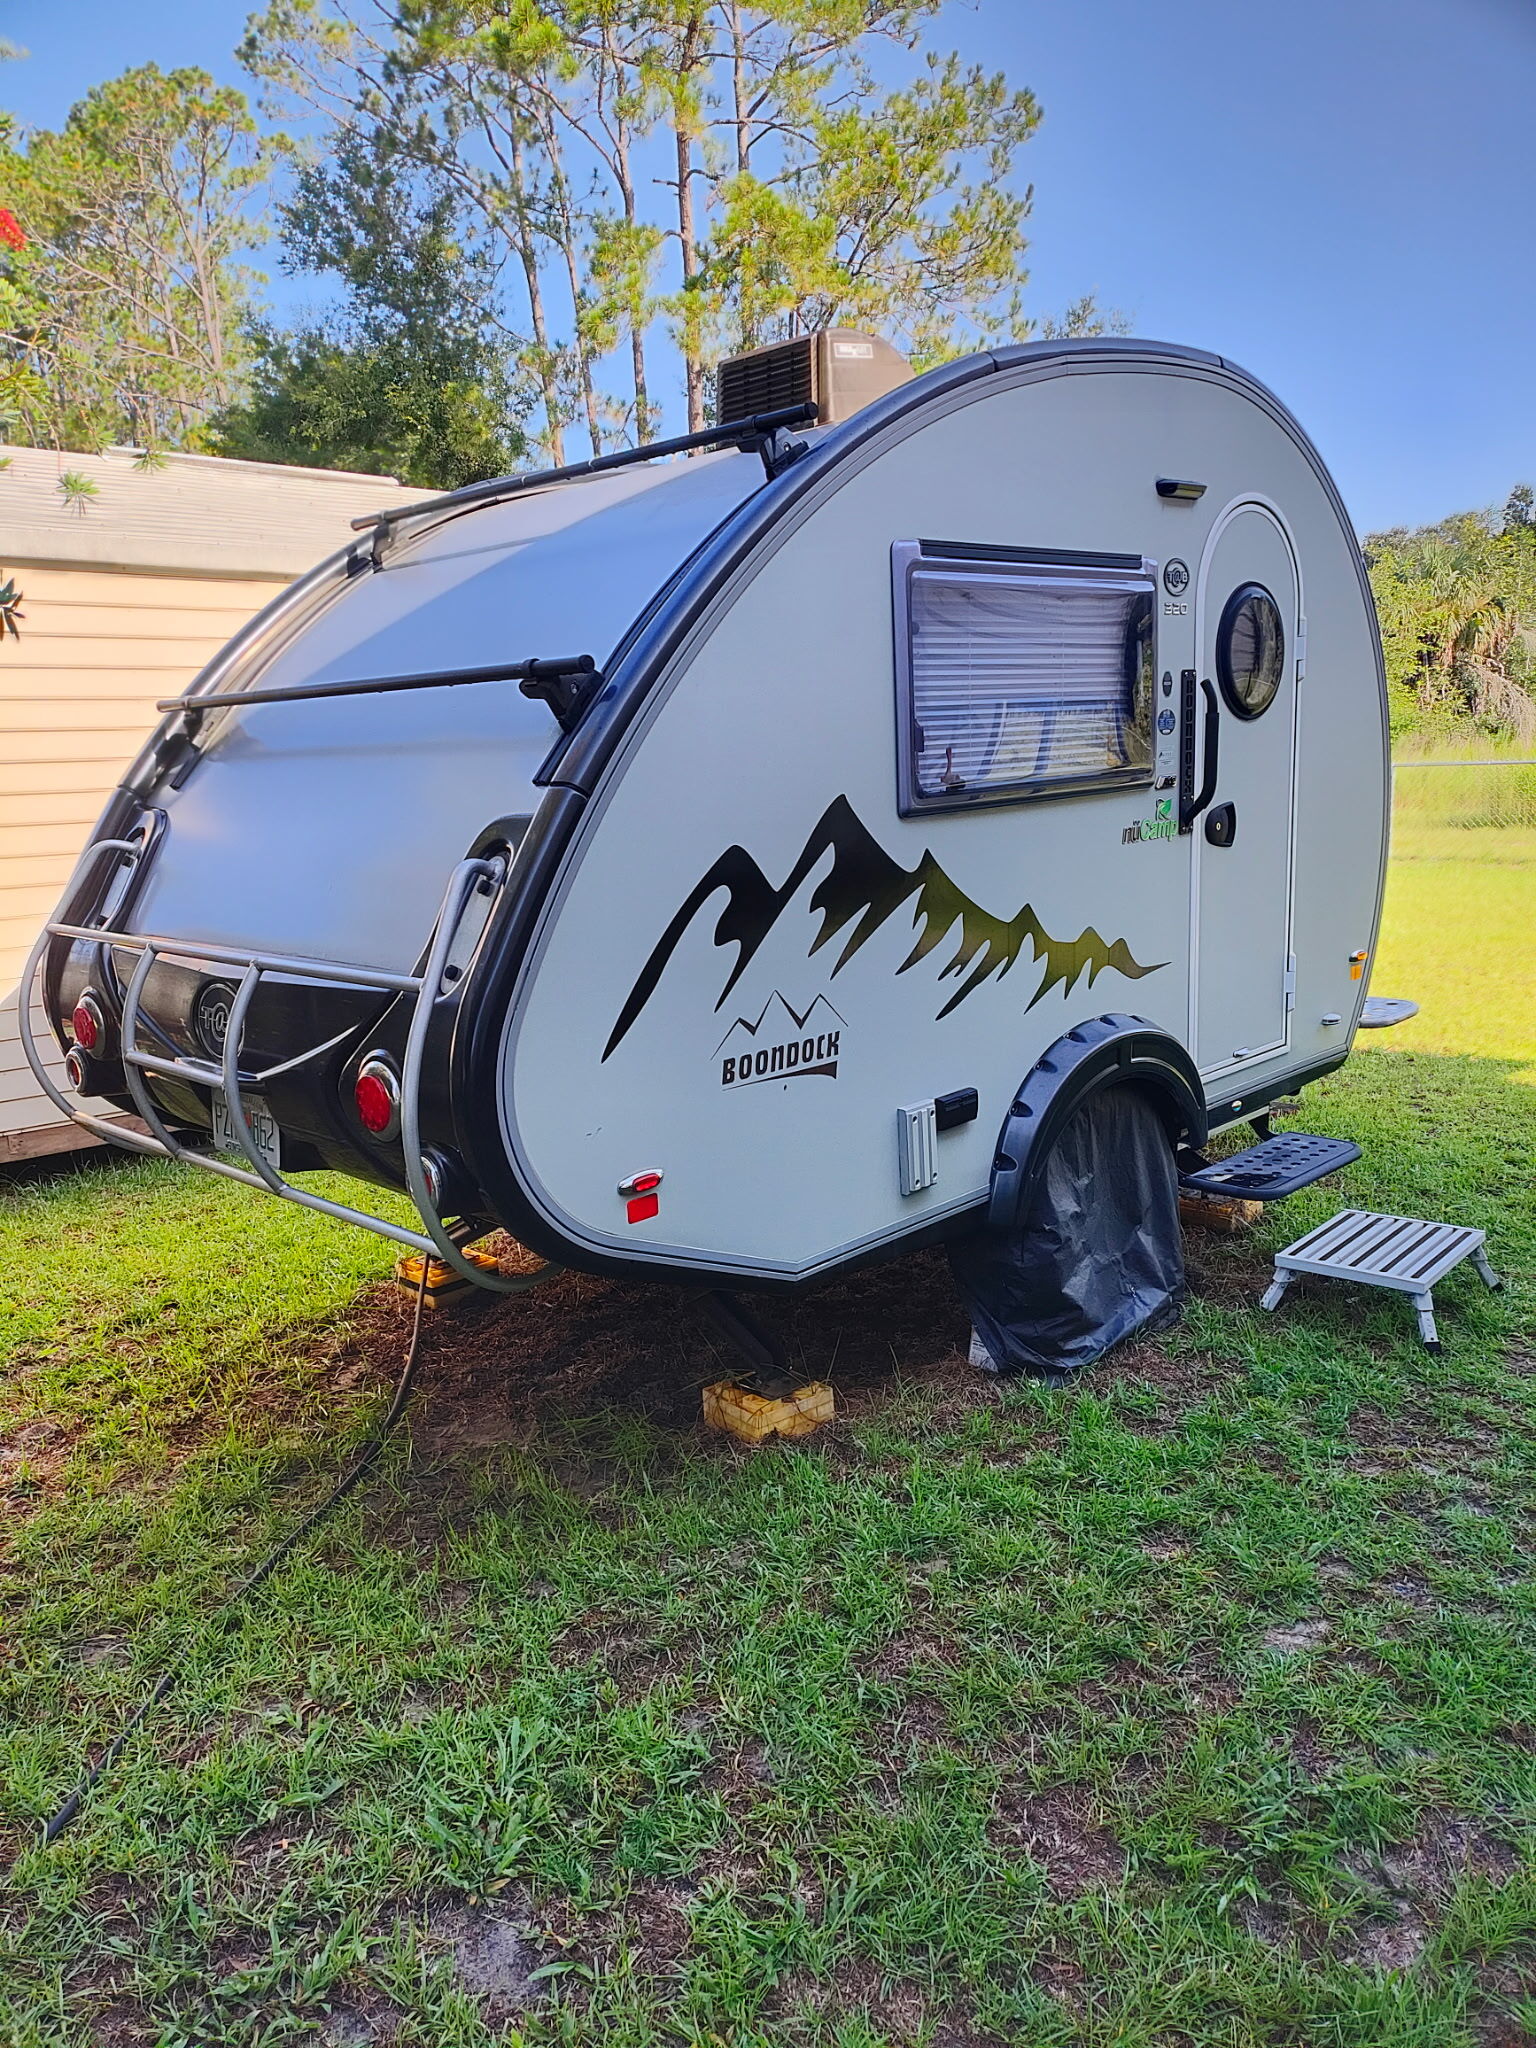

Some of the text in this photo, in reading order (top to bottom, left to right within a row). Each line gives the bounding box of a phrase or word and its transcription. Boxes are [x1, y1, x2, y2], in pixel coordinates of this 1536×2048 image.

[1164, 602, 1188, 616] 320
[1121, 820, 1179, 845] nüCamp
[721, 1030, 841, 1086] BOONDOCK
